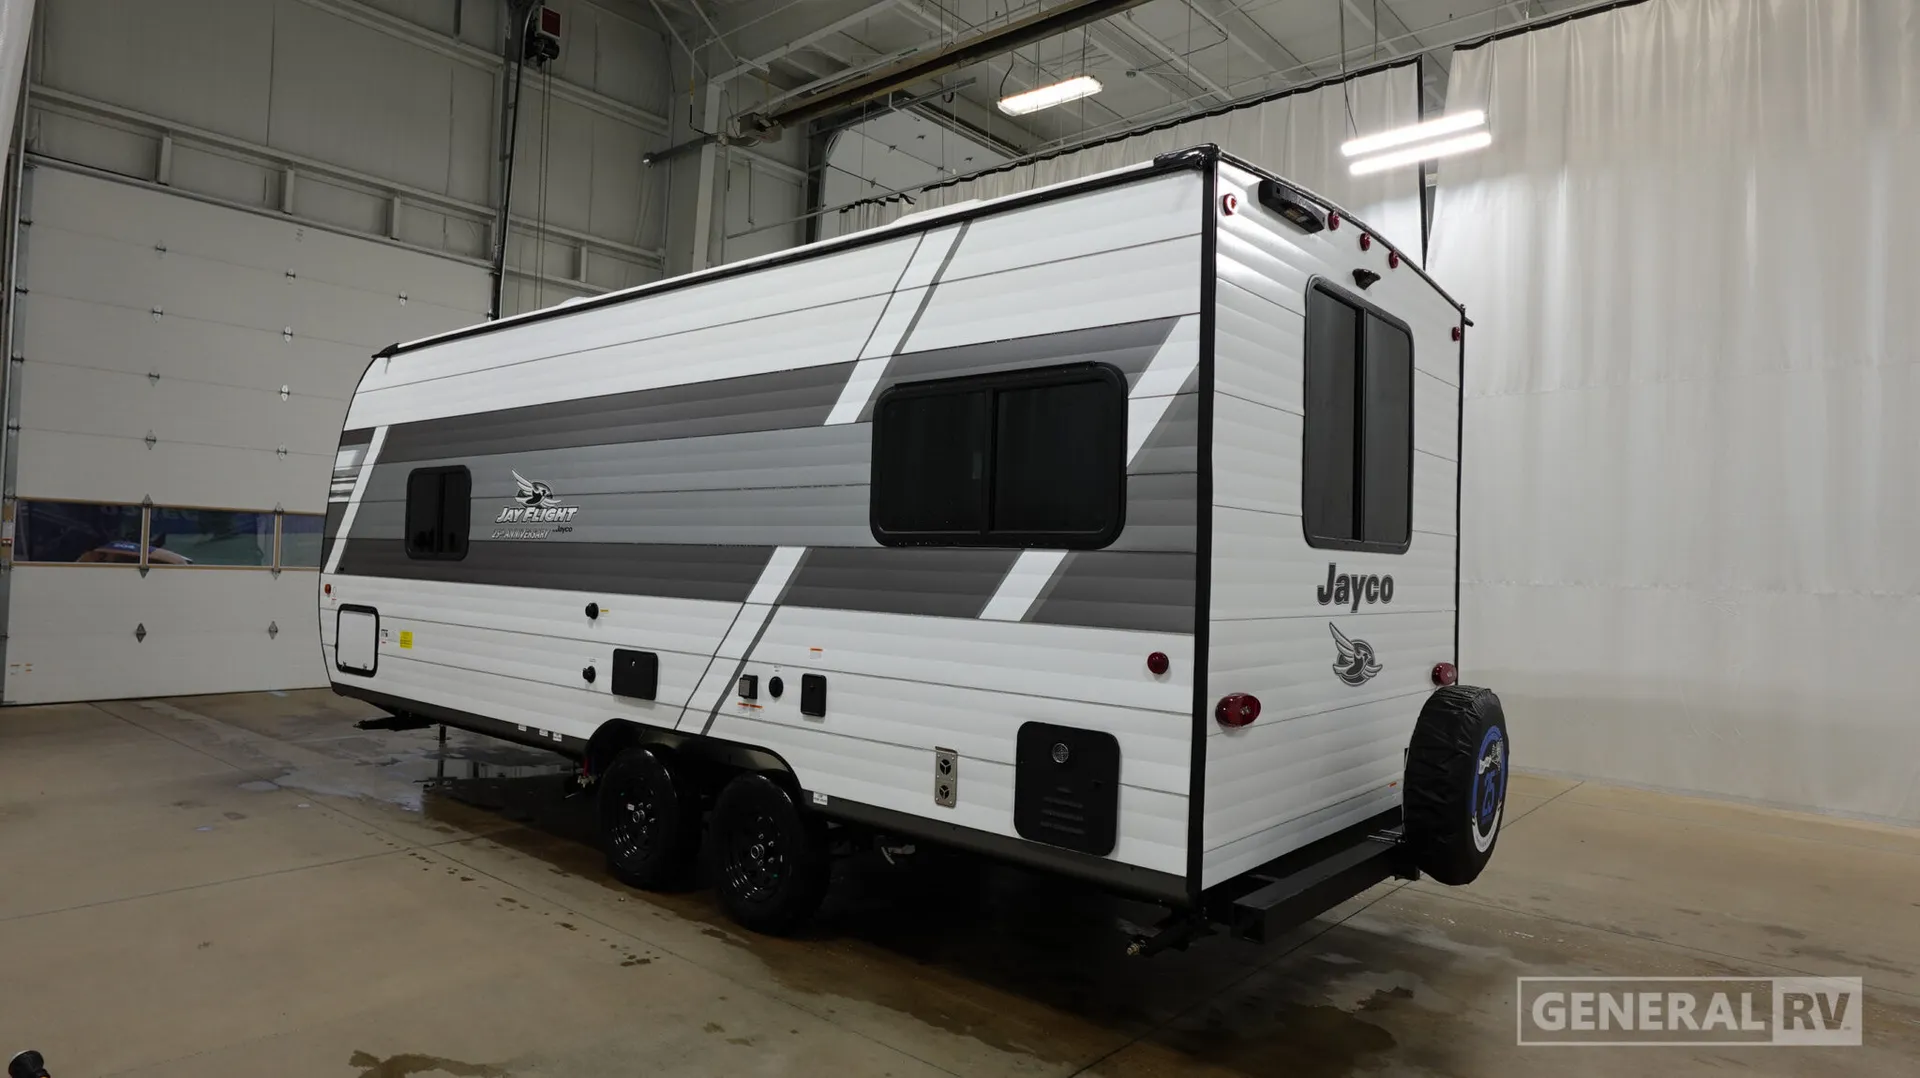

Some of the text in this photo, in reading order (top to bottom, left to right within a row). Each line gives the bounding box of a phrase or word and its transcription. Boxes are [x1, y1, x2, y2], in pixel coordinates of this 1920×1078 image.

[496, 507, 578, 523] JAY FLIGHT
[1317, 562, 1394, 613] Jayco
